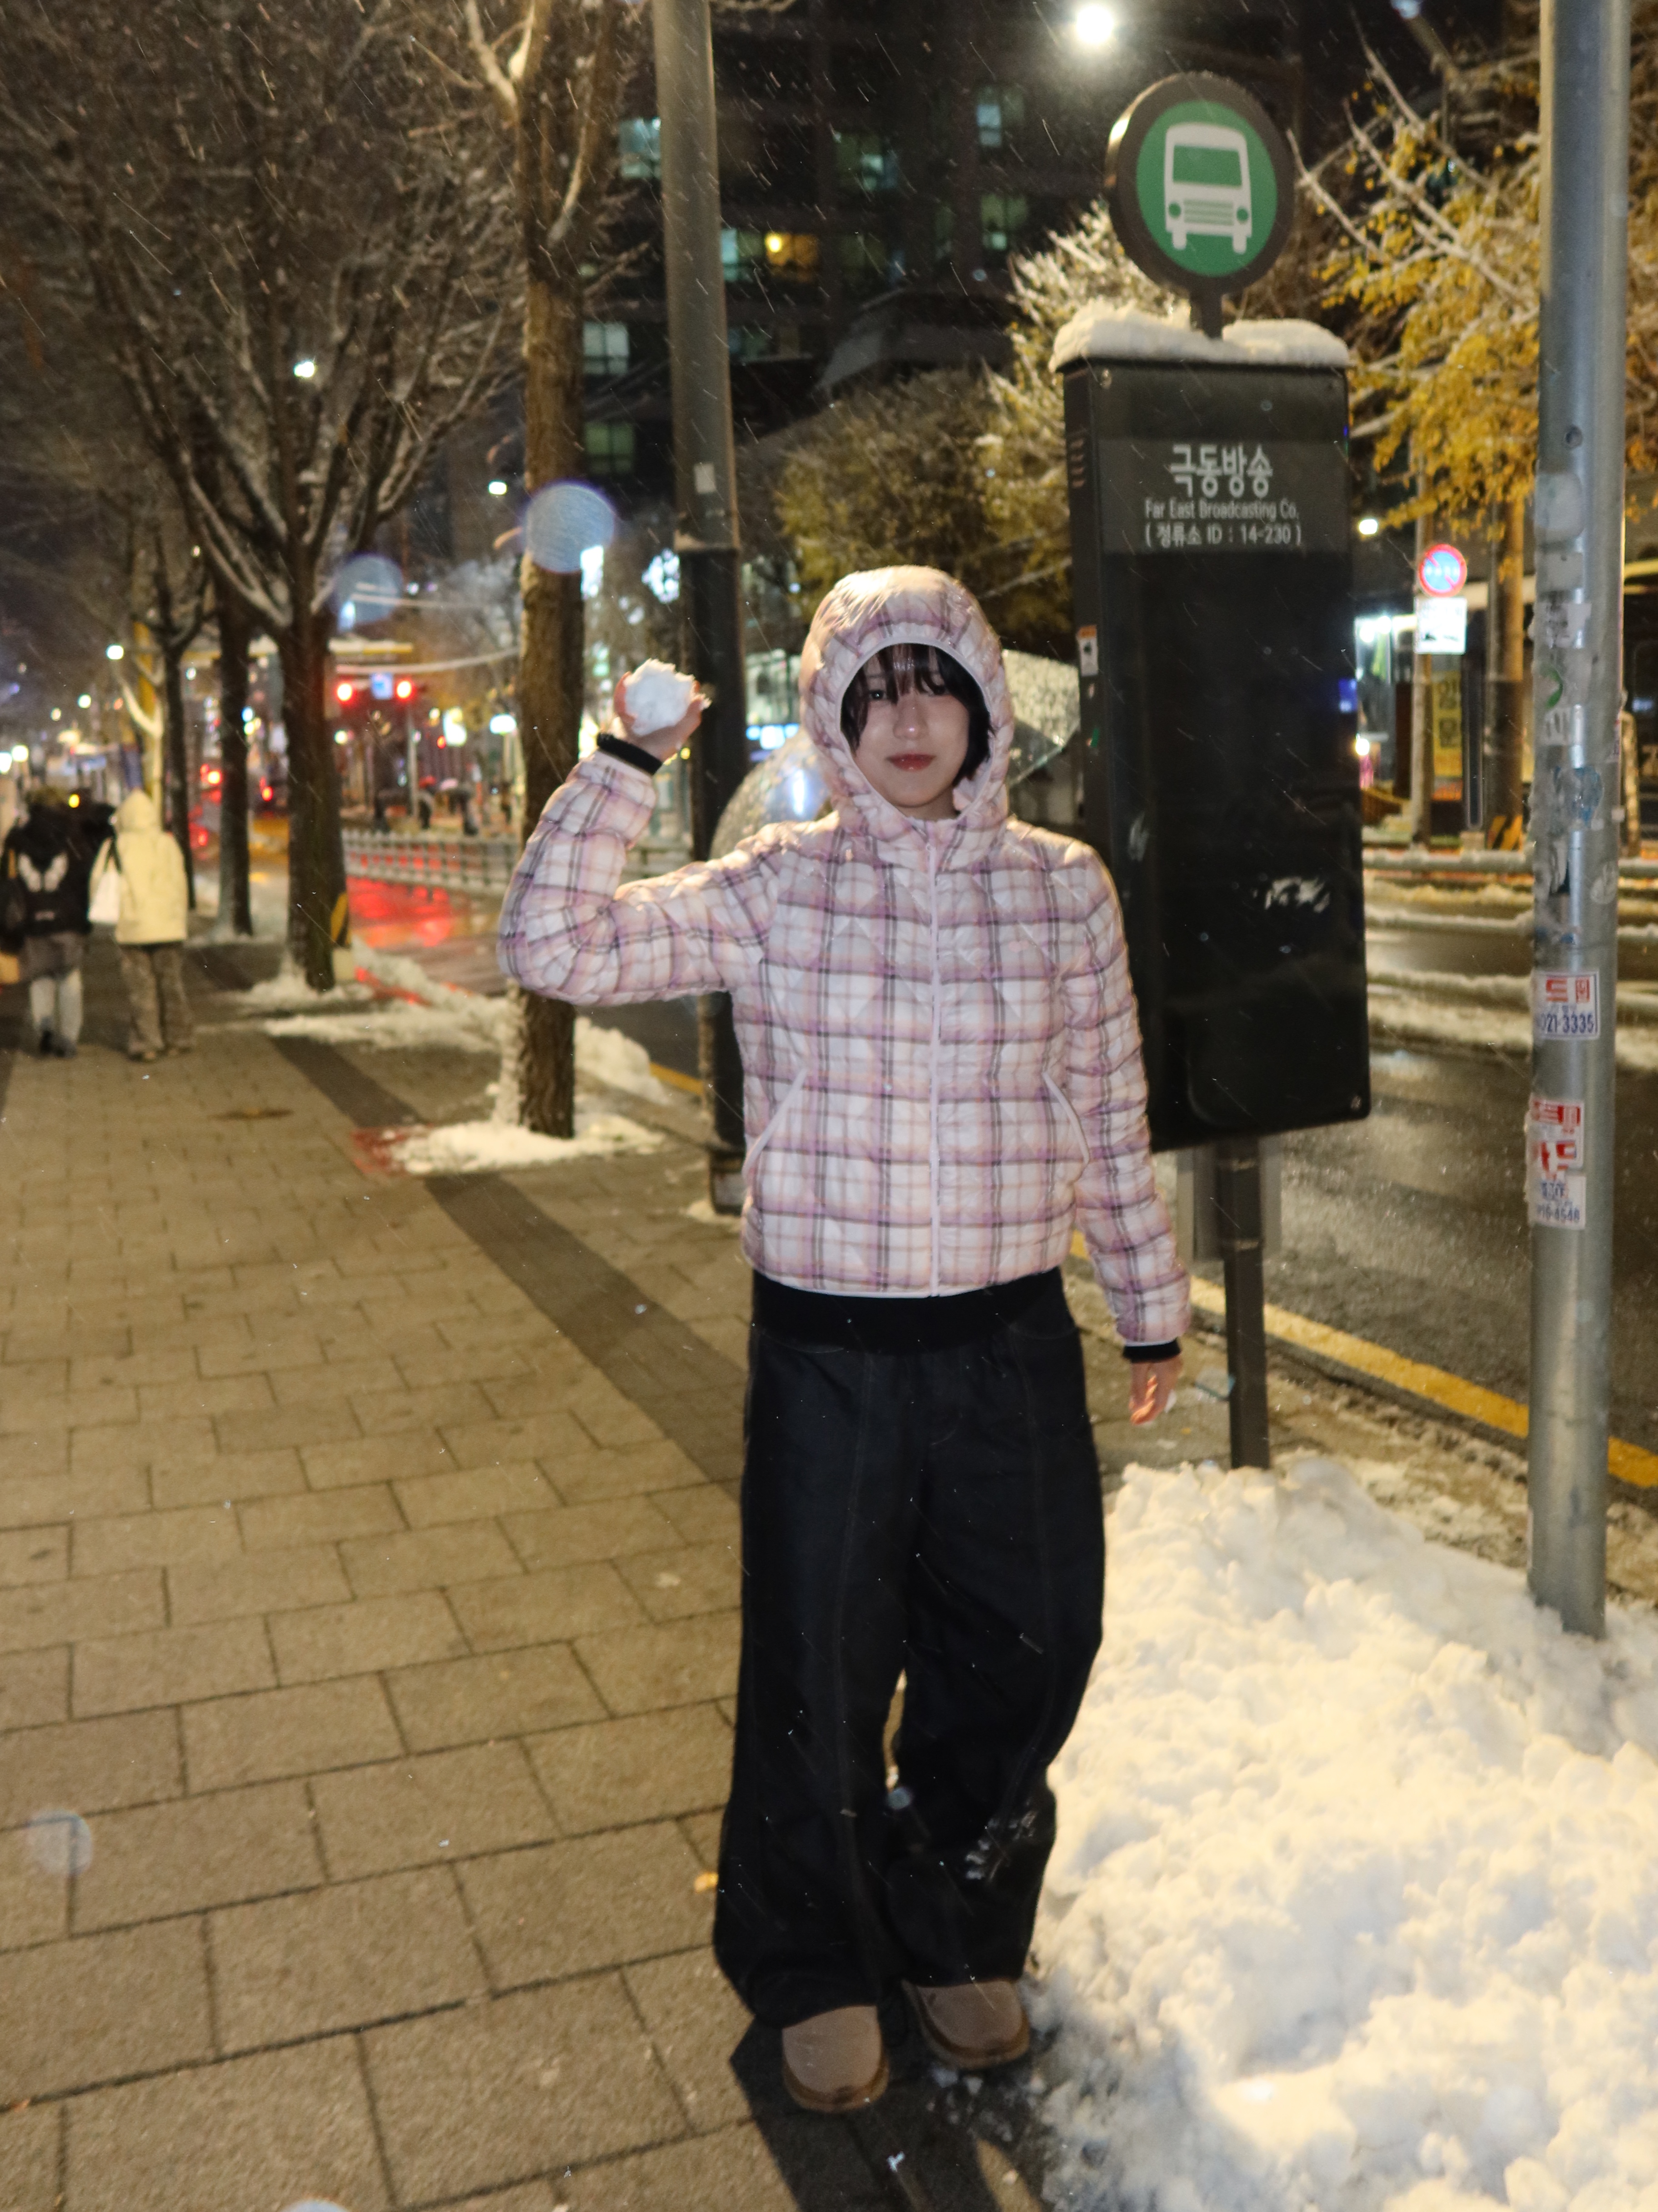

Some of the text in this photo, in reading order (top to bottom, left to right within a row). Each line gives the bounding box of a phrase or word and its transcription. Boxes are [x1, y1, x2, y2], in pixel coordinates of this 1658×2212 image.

[1170, 443, 1273, 498] 극동방송
[1146, 497, 1164, 518] Far
[1170, 497, 1195, 519] East
[1199, 498, 1277, 522] Broadcasting
